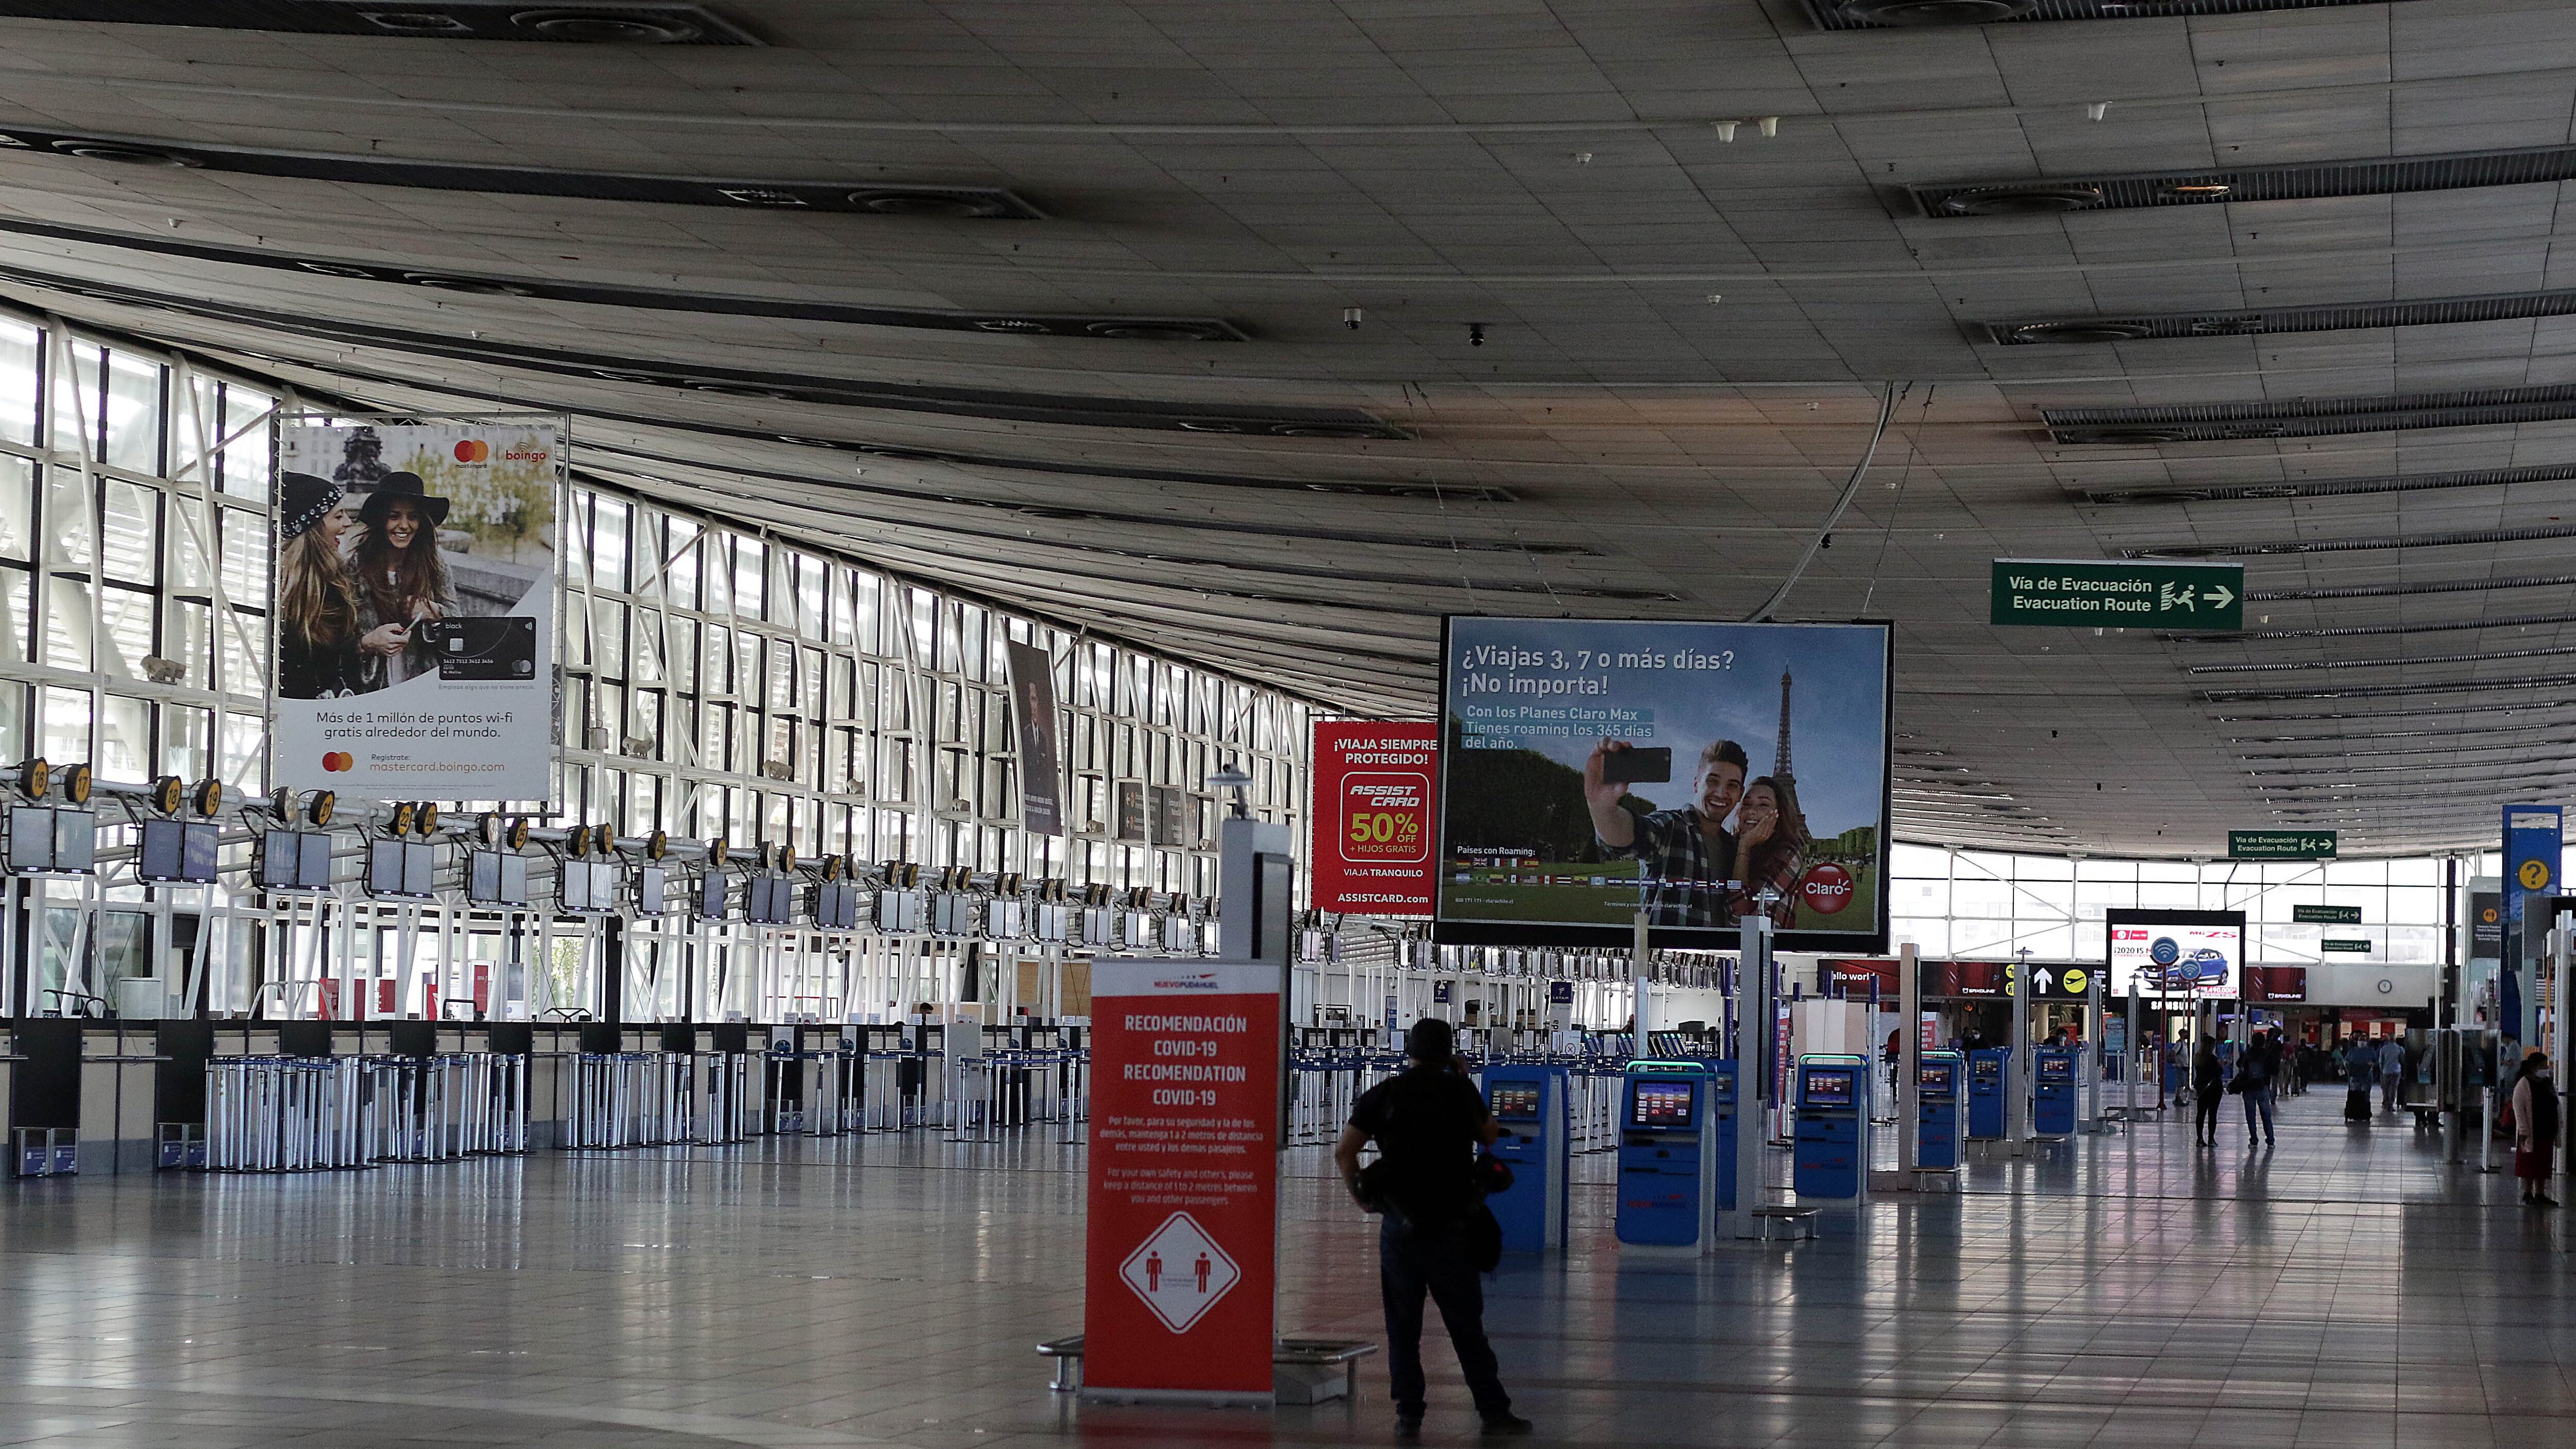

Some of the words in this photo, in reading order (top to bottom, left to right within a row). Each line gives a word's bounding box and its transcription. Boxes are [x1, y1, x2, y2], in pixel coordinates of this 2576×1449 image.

[506, 450, 546, 462] boingo
[2009, 577, 2033, 589] Vía
[2038, 577, 2057, 590] de
[2062, 578, 2152, 592] Evacuación
[2013, 596, 2100, 610] Evacuation
[2105, 598, 2151, 612] Route
[1463, 645, 1544, 670] ¿Viajas
[1550, 650, 1570, 670] 3,
[1578, 651, 1591, 670] 7
[1598, 652, 1611, 667] o
[1619, 647, 1666, 668] más
[1674, 649, 1734, 670] días?
[1463, 672, 1501, 696] ¡No
[1509, 673, 1607, 698] importa!
[317, 713, 343, 722] Más
[347, 712, 361, 722] de
[367, 713, 373, 722] 1
[378, 712, 414, 722] millón
[419, 712, 434, 722] de
[438, 714, 482, 725] puntos
[486, 712, 512, 722] wi-fi
[1467, 705, 1492, 717] Con
[1496, 706, 1516, 718] los
[1520, 706, 1565, 719] Planes
[1570, 707, 1605, 719] Claro
[1611, 709, 1637, 720] Max
[325, 728, 361, 739] gratis
[366, 727, 427, 737] alrededor
[431, 727, 448, 737] del
[453, 727, 500, 737] mundo.
[1466, 721, 1510, 734] Tienes
[1515, 724, 1569, 738] roaming
[1574, 724, 1593, 735] los
[1597, 724, 1620, 736] 365
[1624, 724, 1651, 736] días
[1334, 739, 1377, 751] ¡VIAJA
[1380, 739, 1437, 750] SIEMPRE
[1465, 737, 1485, 748] del
[1490, 737, 1517, 748] año.
[1346, 753, 1428, 764] PROTEGIDO!
[370, 763, 504, 773] mastercard.boingo.com
[35, 772, 44, 787] 16
[78, 777, 88, 792] 17
[168, 788, 178, 803] 18
[1350, 785, 1416, 795] ASSIST
[209, 792, 218, 806] 19
[1371, 797, 1420, 806] CARD
[400, 812, 410, 827] 22
[1350, 813, 1418, 842] 50%
[1458, 846, 1482, 854] Países
[1499, 847, 1535, 856] Roaming:
[1806, 882, 1845, 895] Claro
[1337, 894, 1428, 903] ASSISTCARD.com
[1833, 972, 1847, 980] ello
[1125, 1014, 1246, 1032] RECOMENDACIÓN
[1154, 1040, 1217, 1056] COVID-19
[1124, 1064, 1246, 1082] RECOMENDATION
[1153, 1089, 1216, 1106] COVID-19
[1109, 1117, 1122, 1125] Por
[1147, 1119, 1164, 1127] para
[1177, 1118, 1214, 1127] seguridad
